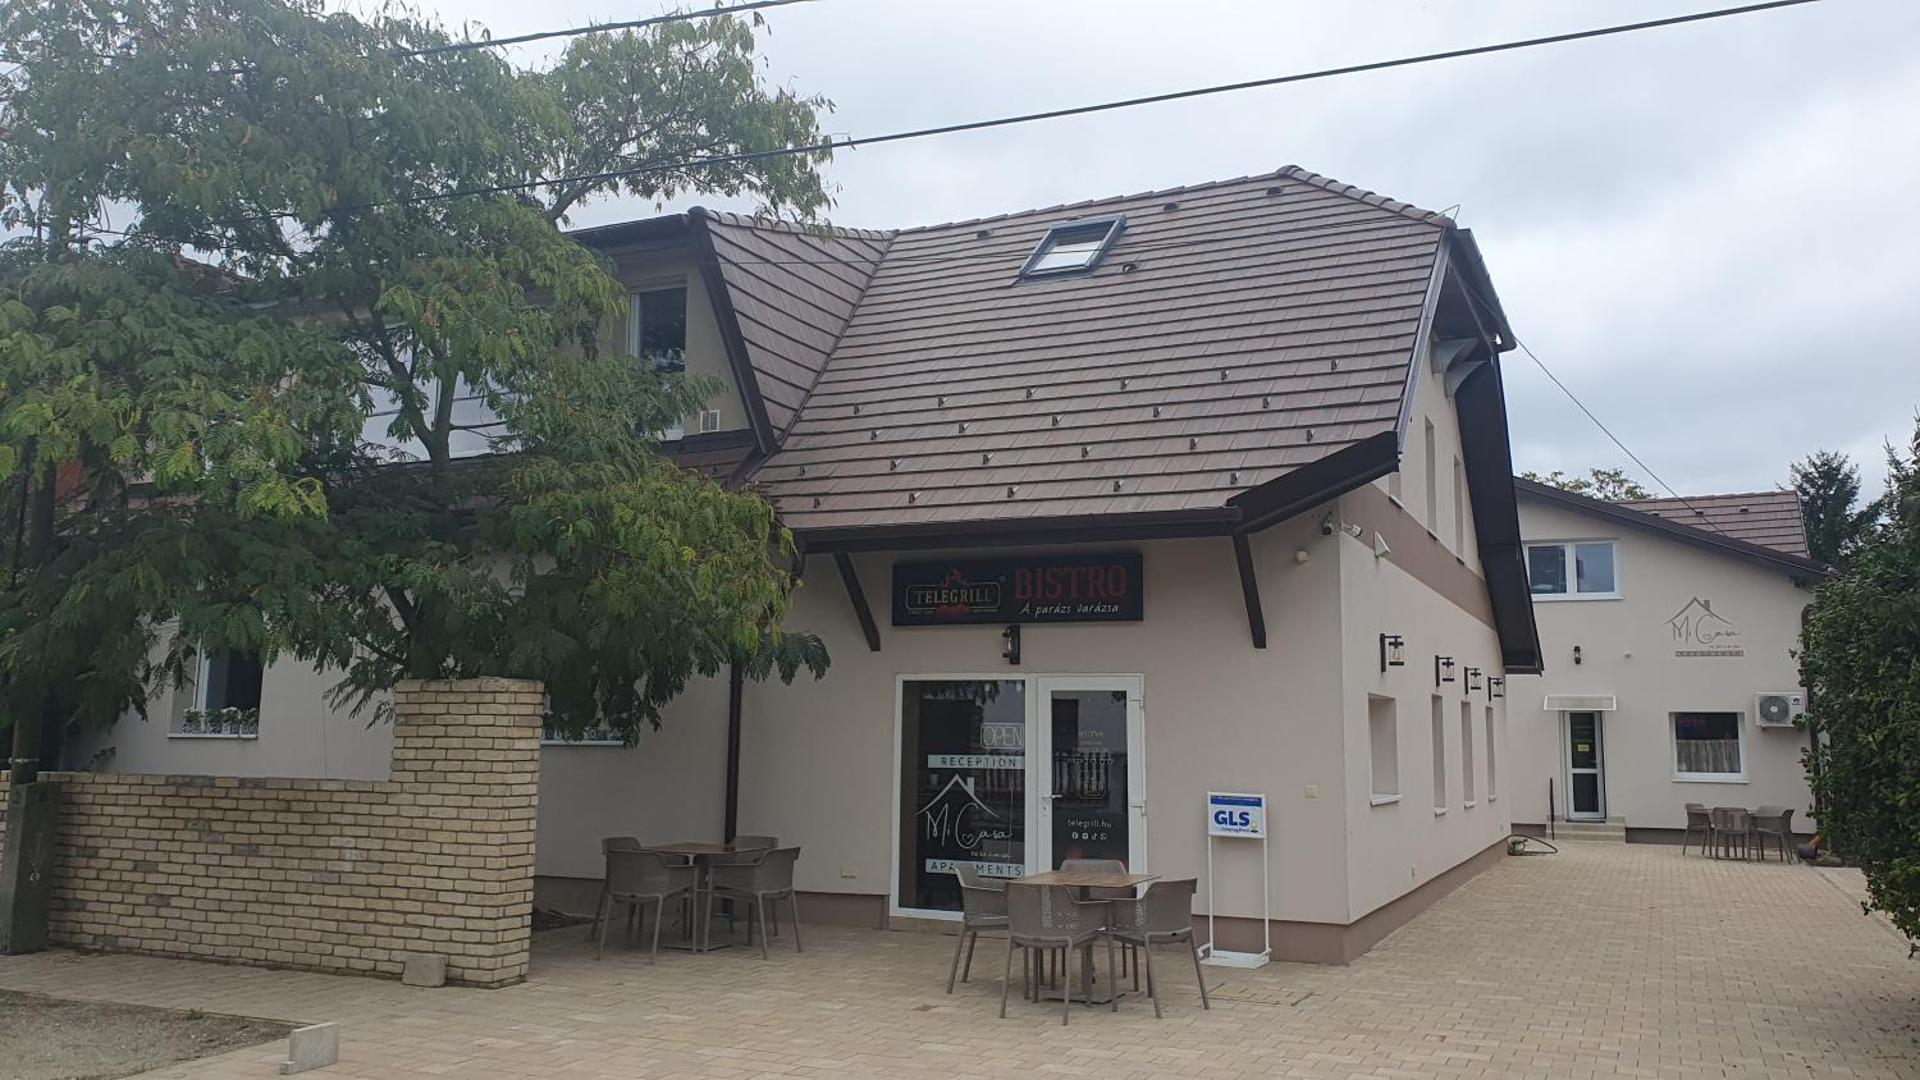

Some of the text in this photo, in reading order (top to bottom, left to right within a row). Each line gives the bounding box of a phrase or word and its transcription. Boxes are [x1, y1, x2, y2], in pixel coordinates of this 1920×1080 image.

[1014, 565, 1128, 600] BISTRO
[915, 588, 992, 605] TELEGRILL
[1019, 600, 1031, 615] A
[1034, 602, 1072, 618] parázs
[983, 726, 1022, 746] OPEN
[941, 757, 1017, 767] RECEPTION
[955, 802, 1013, 849] Casa
[1067, 819, 1111, 830] telegrill.hu
[1214, 810, 1250, 827] GLS
[931, 860, 1022, 877] APAMENTS
